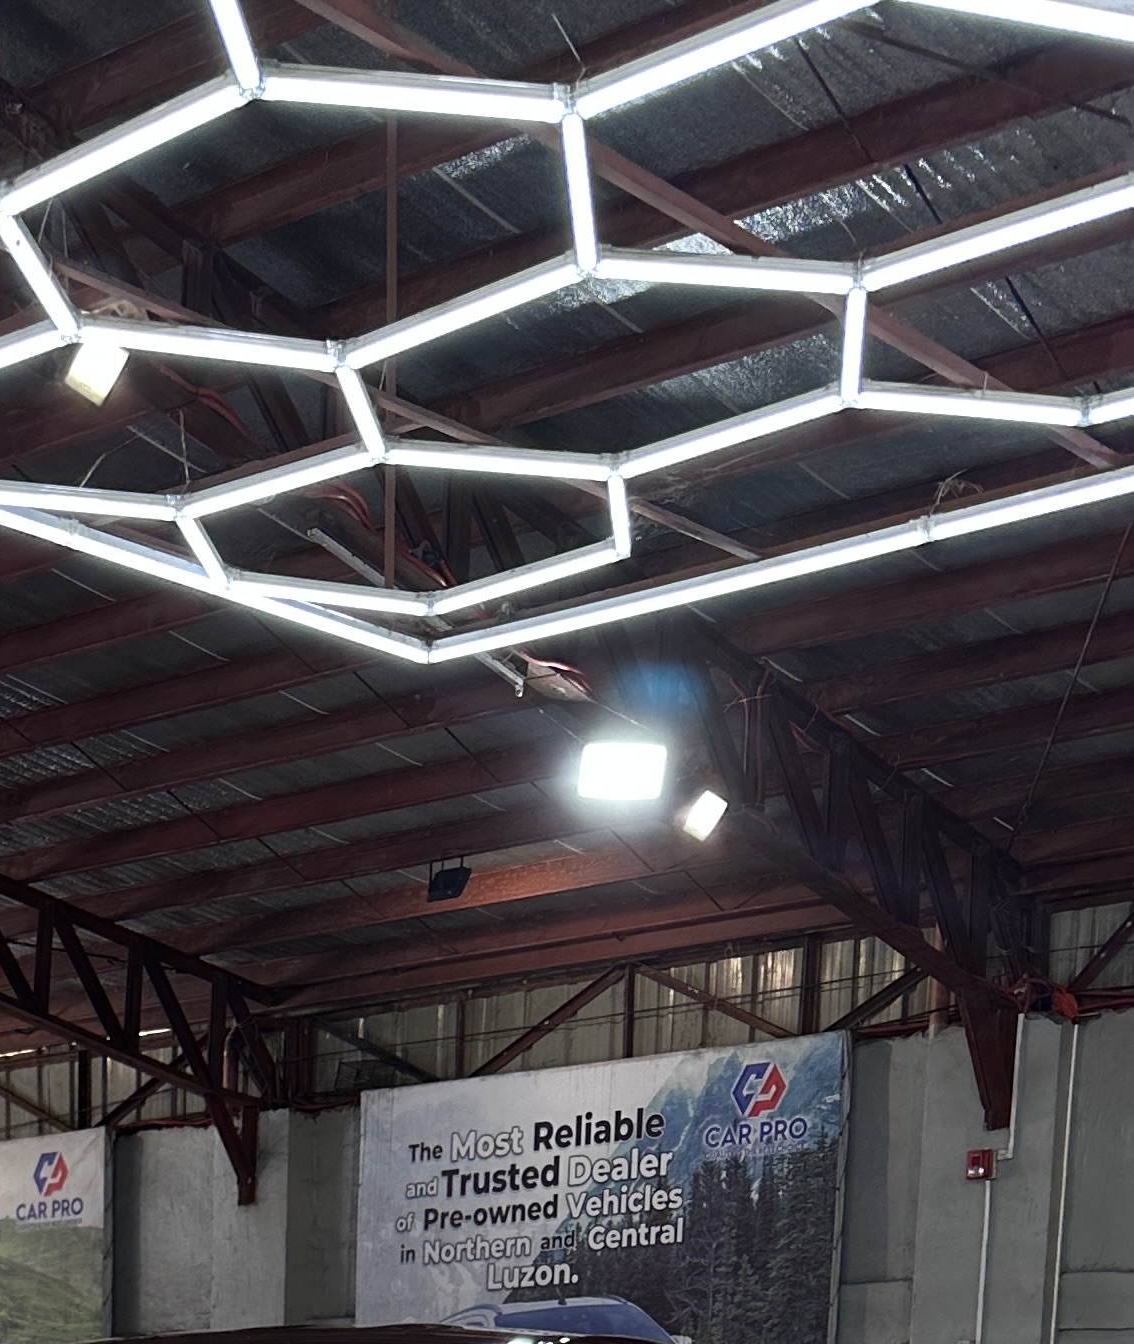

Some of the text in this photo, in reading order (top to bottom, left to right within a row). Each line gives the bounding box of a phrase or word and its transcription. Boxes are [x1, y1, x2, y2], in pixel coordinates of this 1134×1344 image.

[409, 1143, 443, 1162] The
[450, 1126, 524, 1162] Most
[533, 1108, 665, 1151] Reliable
[705, 1117, 807, 1148] CAR PRO
[406, 1176, 438, 1199] and
[442, 1156, 560, 1198] Trusted
[567, 1149, 674, 1187] Dealer
[16, 1197, 84, 1221] CAR PRO
[395, 1183, 683, 1233] of Pre-owned Vehicles
[400, 1218, 684, 1265] in Northern and Central
[486, 1260, 579, 1290] Luzon.
